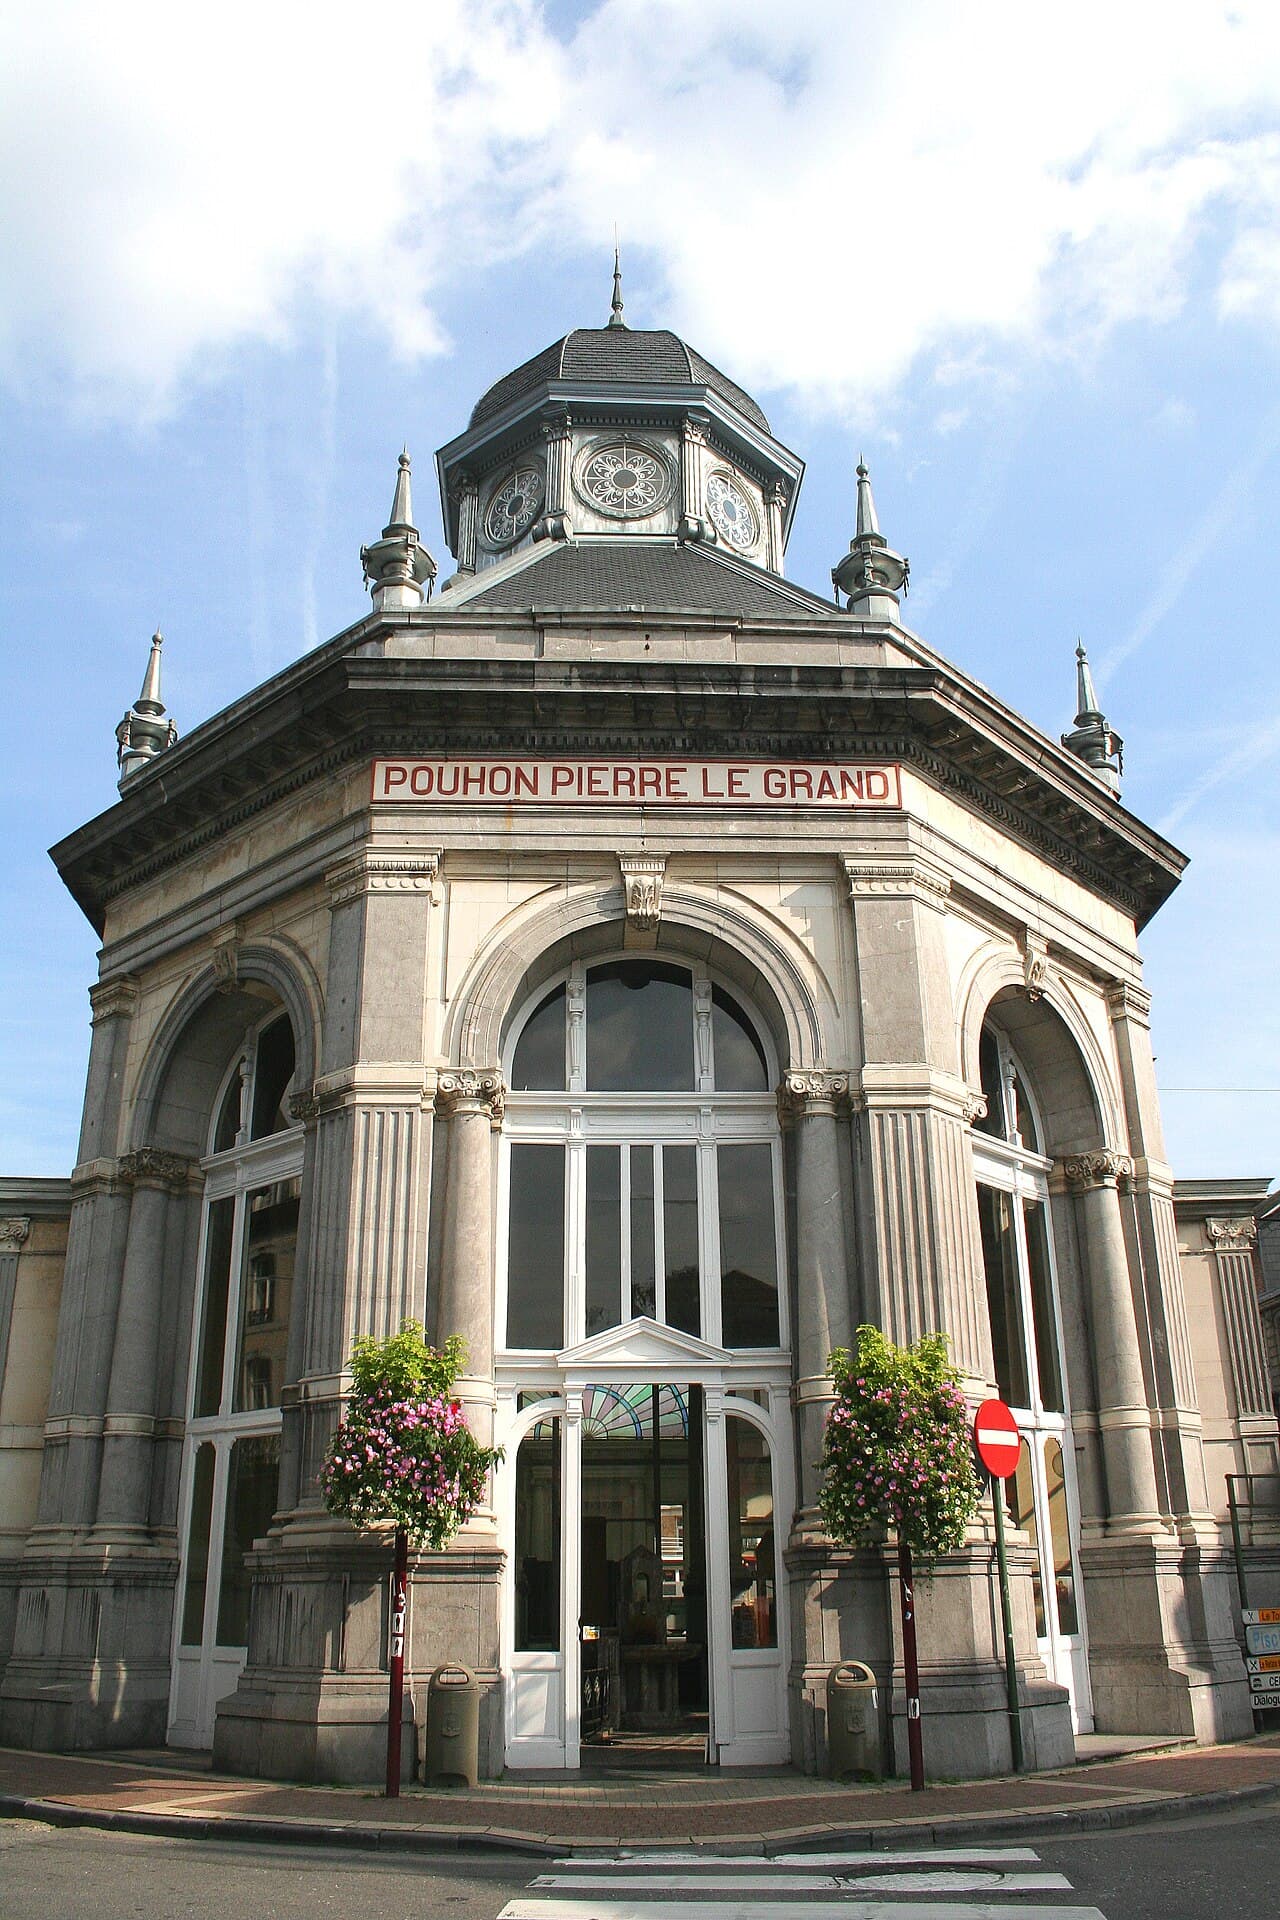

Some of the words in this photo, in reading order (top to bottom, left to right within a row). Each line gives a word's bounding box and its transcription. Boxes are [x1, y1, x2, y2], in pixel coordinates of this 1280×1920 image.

[383, 765, 539, 796] POUHON
[551, 766, 688, 798] PIERRE
[702, 767, 751, 798] LE
[763, 768, 889, 800] GRAND
